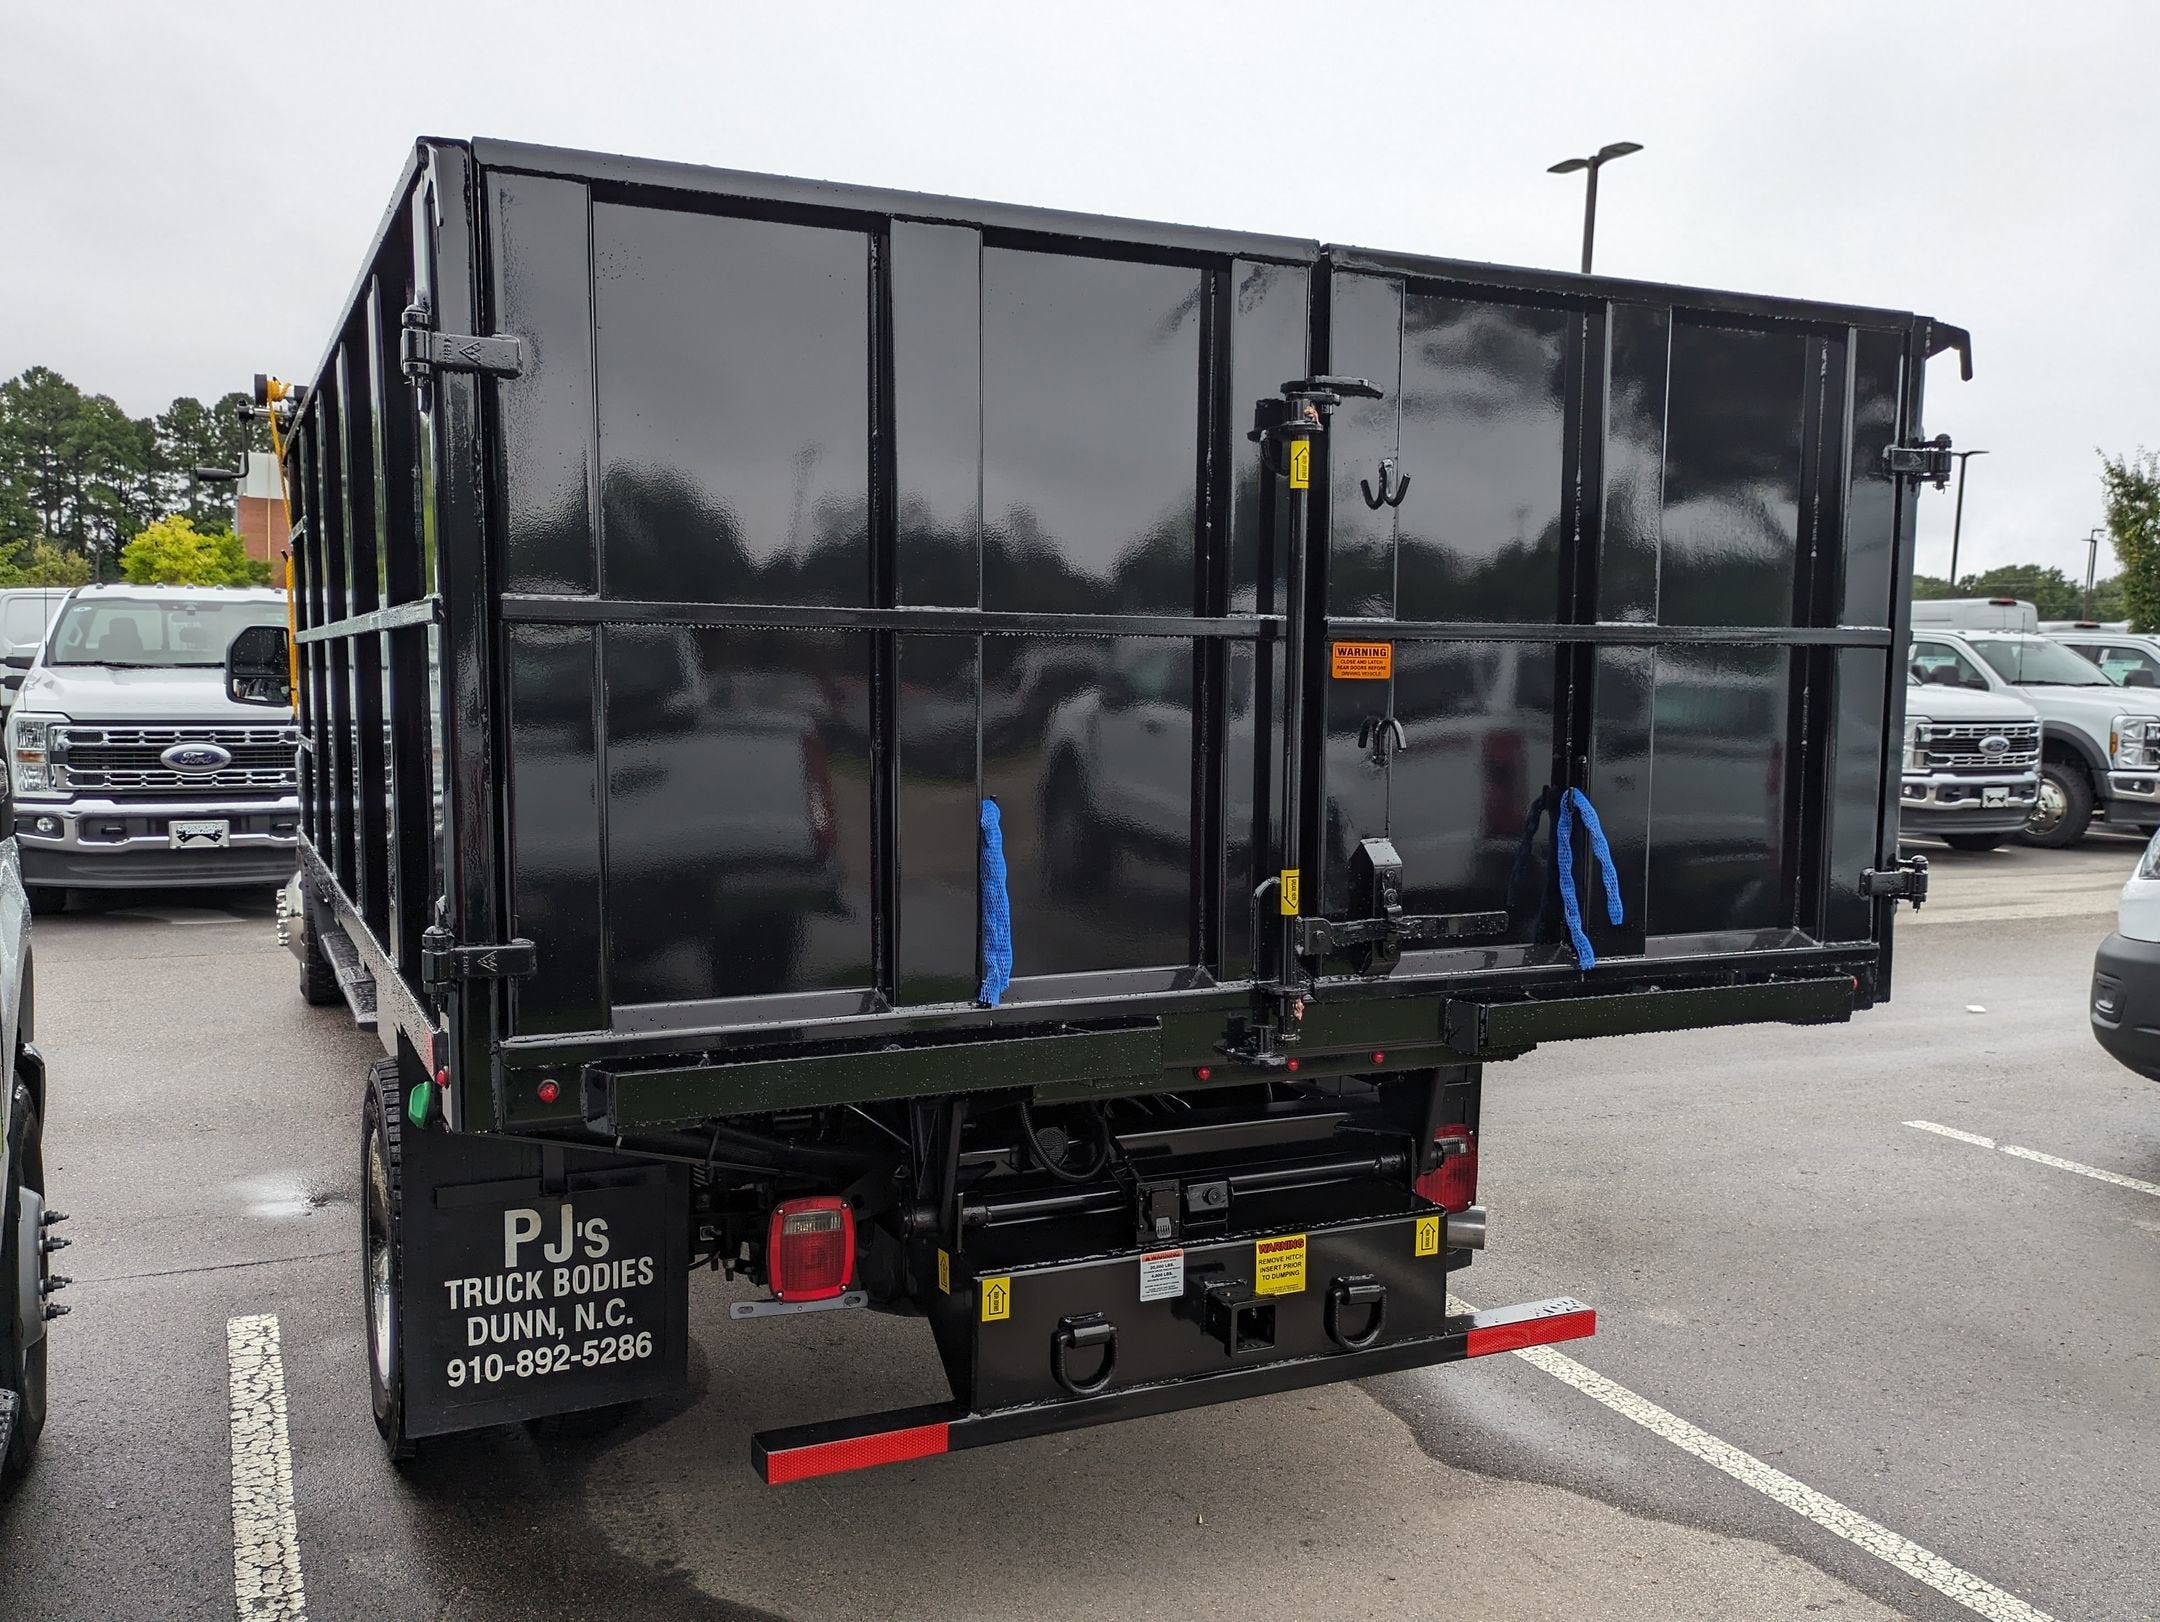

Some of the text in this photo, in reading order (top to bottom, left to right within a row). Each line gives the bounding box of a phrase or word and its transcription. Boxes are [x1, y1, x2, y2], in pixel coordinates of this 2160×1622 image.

[1337, 647, 1386, 657] WARNING
[180, 751, 212, 765] Ford
[1258, 1238, 1304, 1254] WARNING
[1258, 1253, 1303, 1265] REMOVE HITCH
[1260, 1261, 1302, 1273] INSERT PRIOR
[1272, 1270, 1300, 1280] DUMPING
[444, 1256, 654, 1310] TRUCK BODIES
[467, 1298, 633, 1347] DUNN, N.C.
[447, 1331, 653, 1388] 910-892-5286
